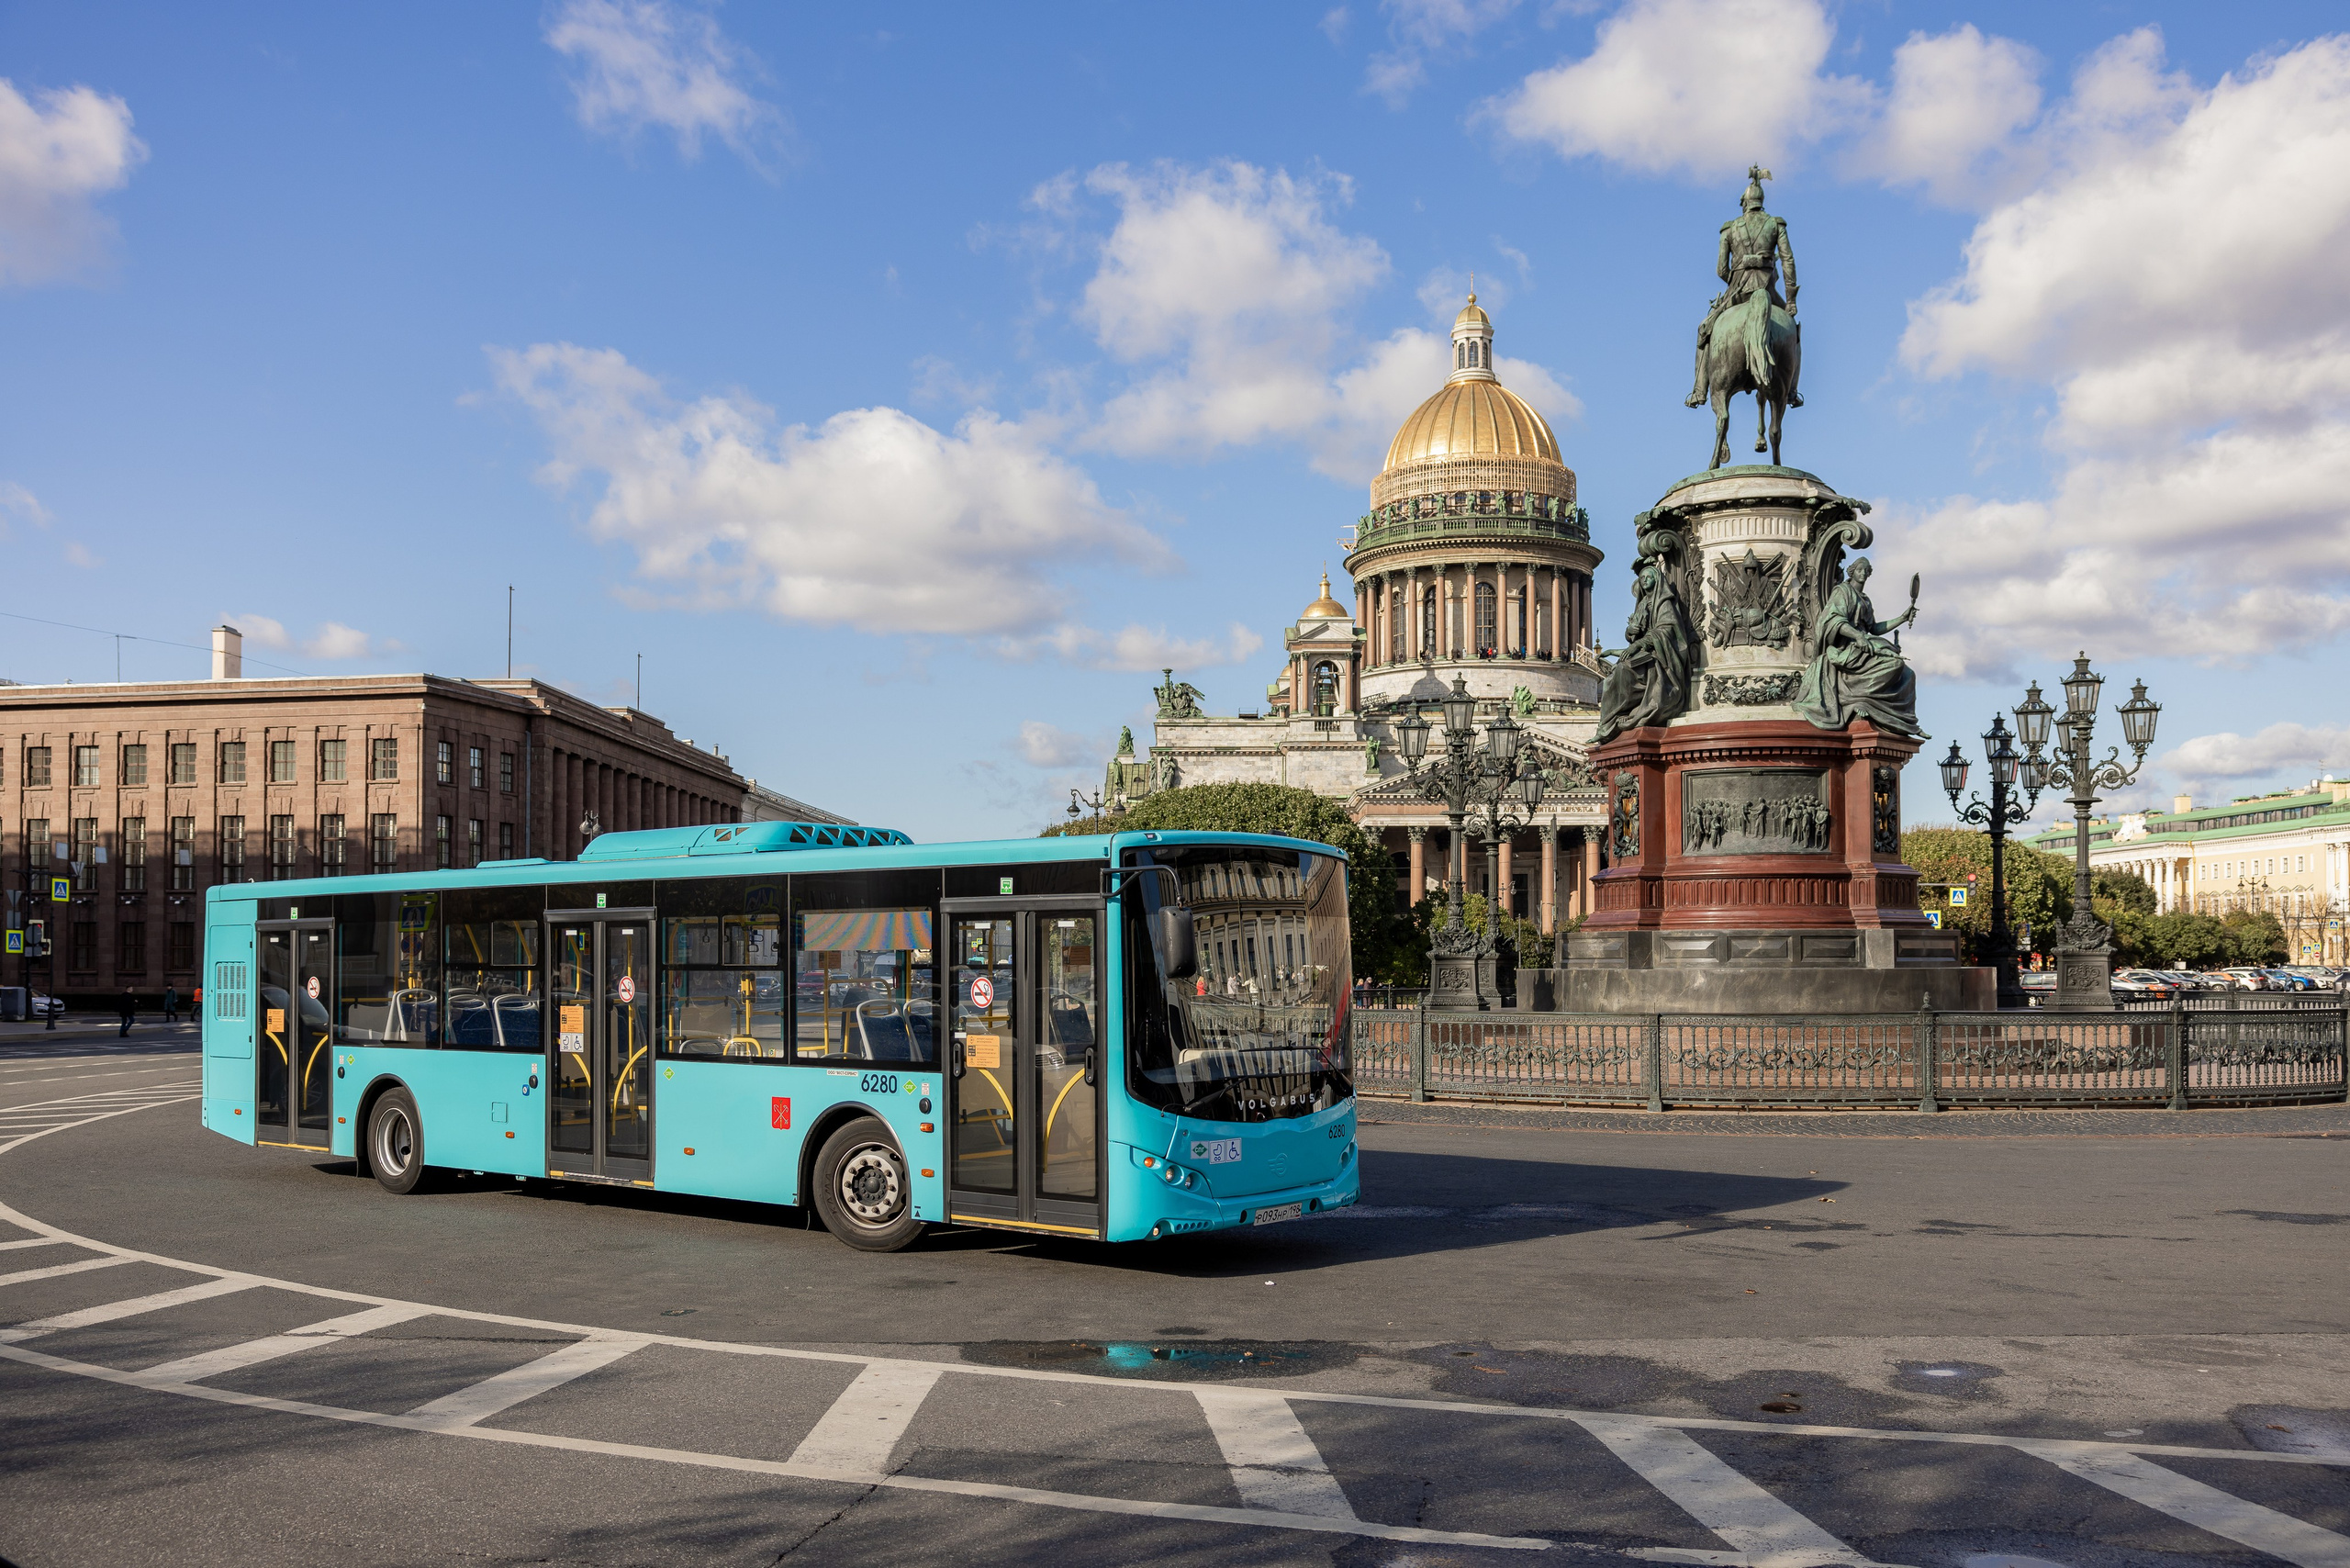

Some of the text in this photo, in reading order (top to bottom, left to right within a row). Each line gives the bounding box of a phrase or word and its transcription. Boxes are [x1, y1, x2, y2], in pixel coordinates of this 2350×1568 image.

[861, 1074, 898, 1093] 6280
[1237, 1093, 1315, 1111] VOLGABUS
[1328, 1124, 1346, 1139] 6280
